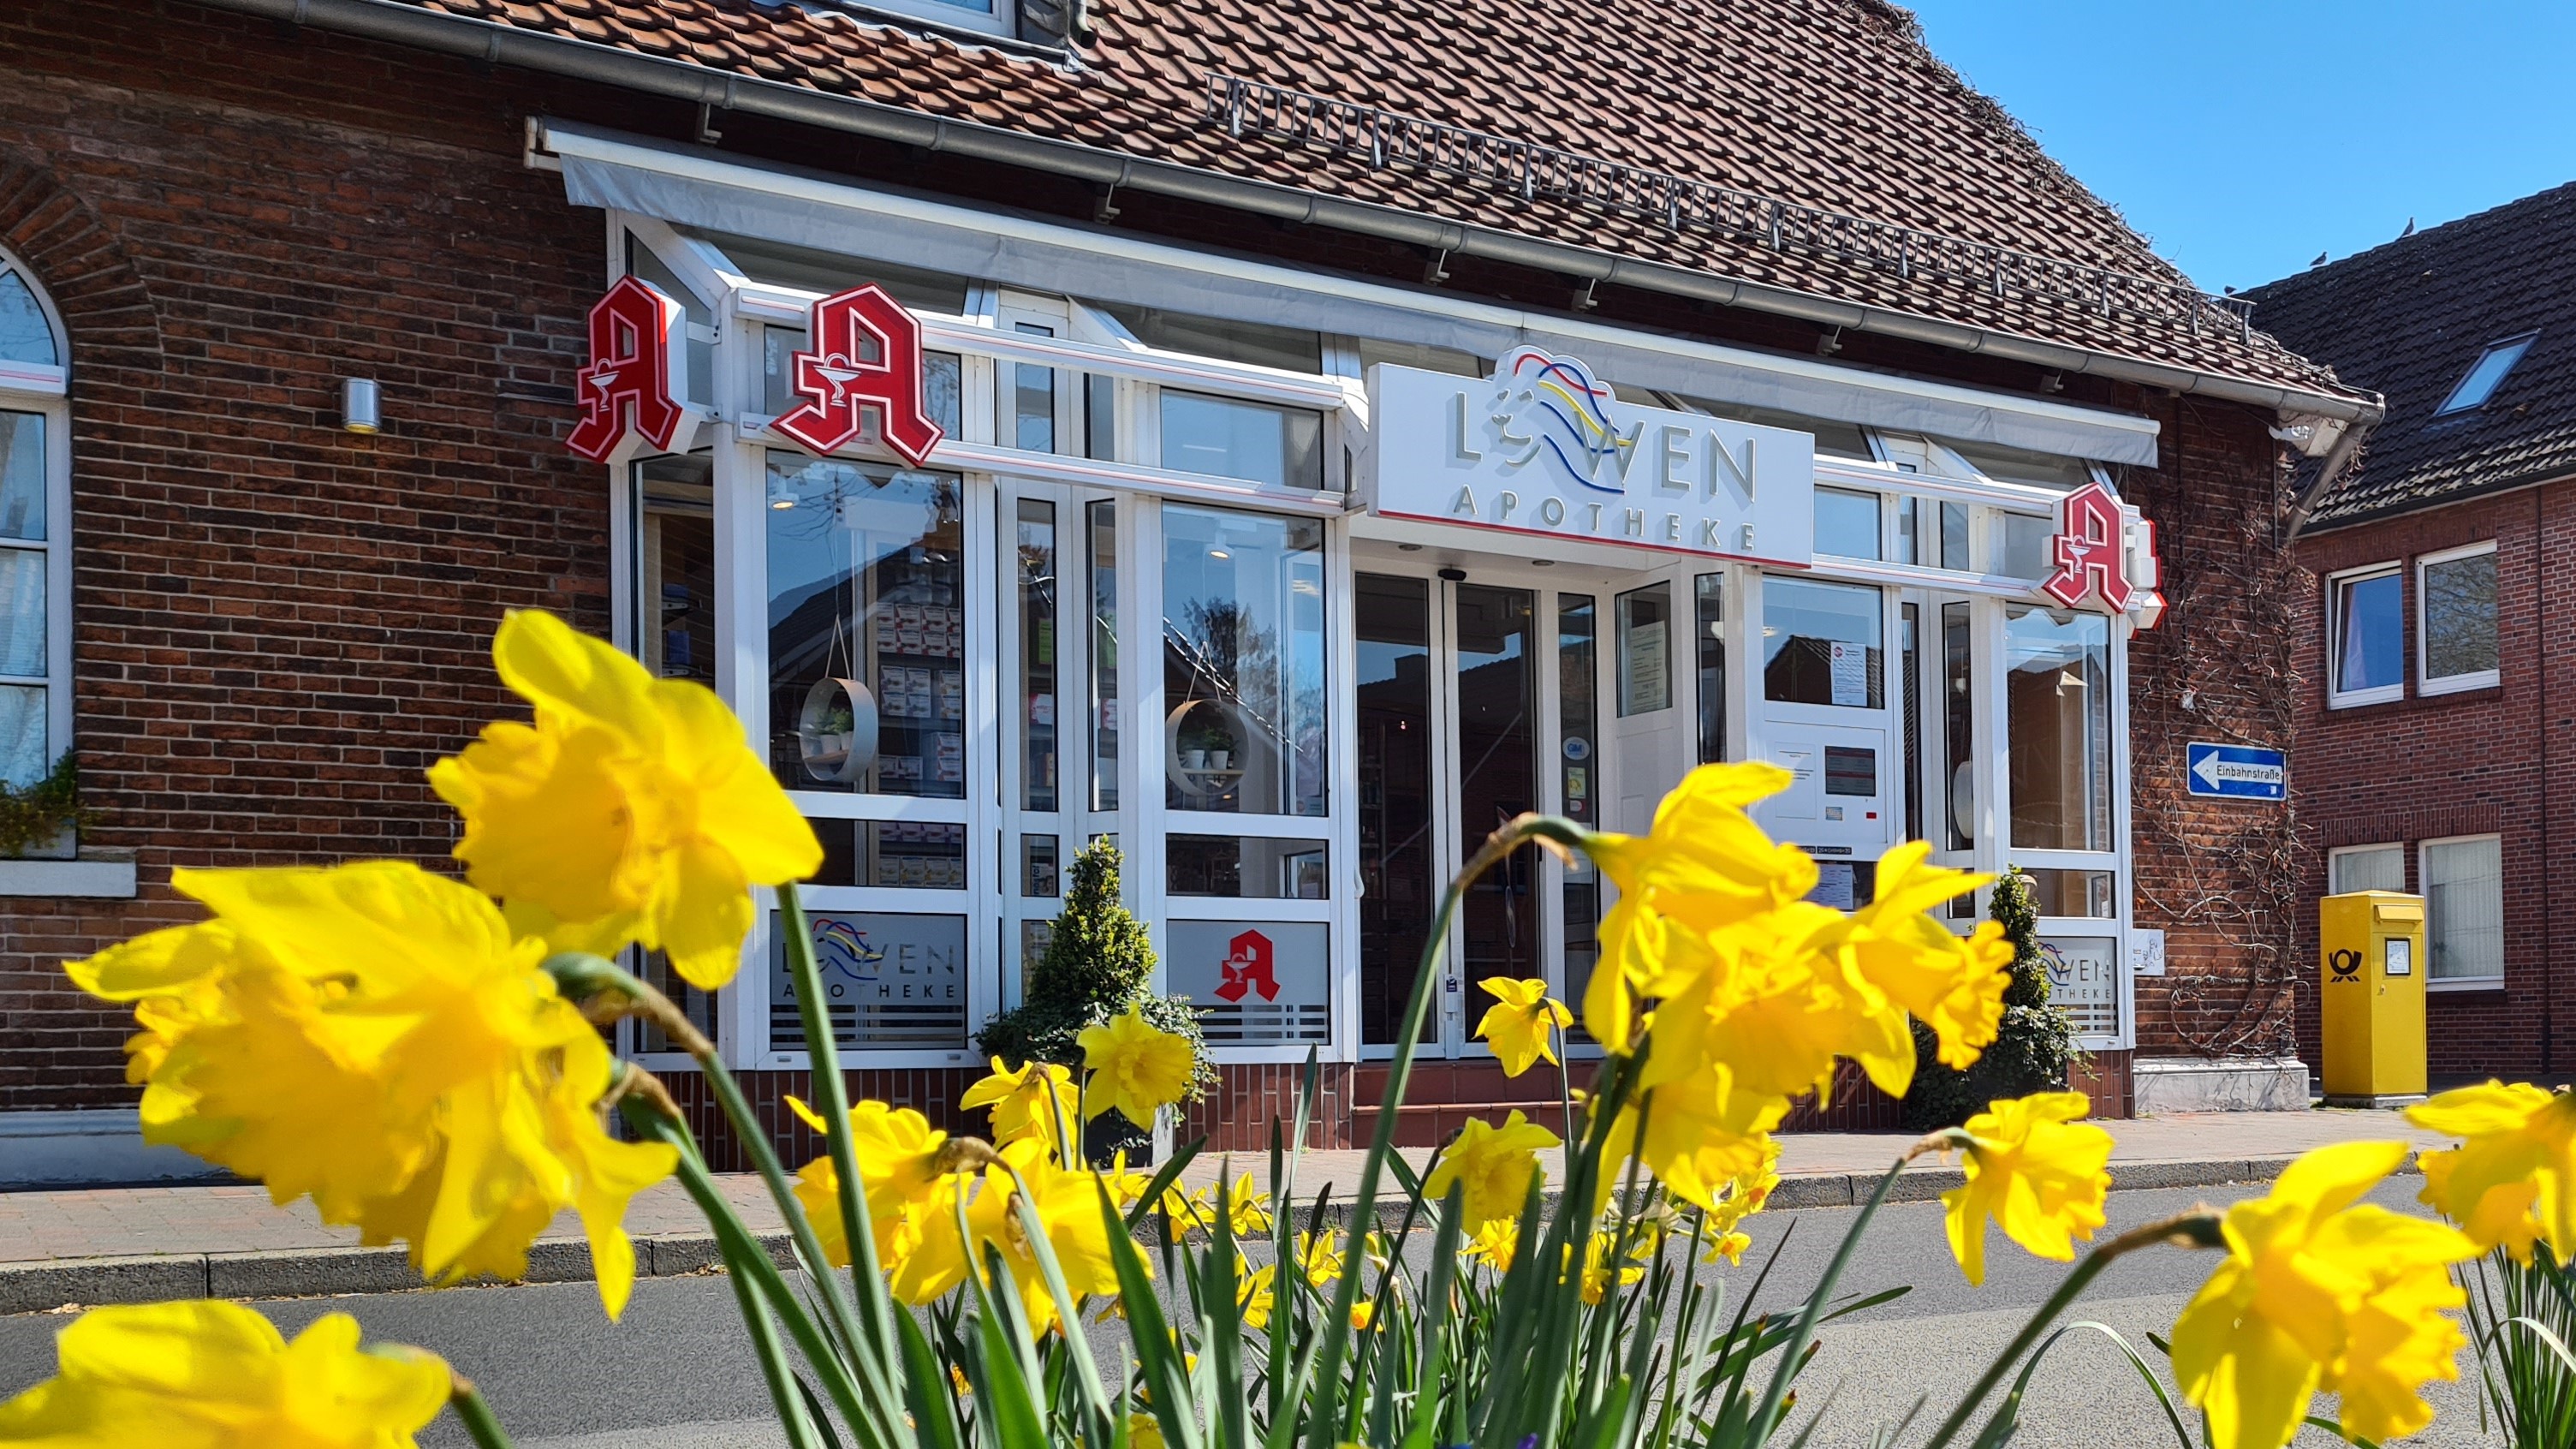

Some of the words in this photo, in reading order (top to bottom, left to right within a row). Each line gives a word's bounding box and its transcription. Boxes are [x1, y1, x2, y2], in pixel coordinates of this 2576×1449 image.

[1453, 484, 1755, 552] APOTHEKE
[2216, 765, 2280, 780] Einbahnstraße
[782, 984, 955, 998] AOTHEKE
